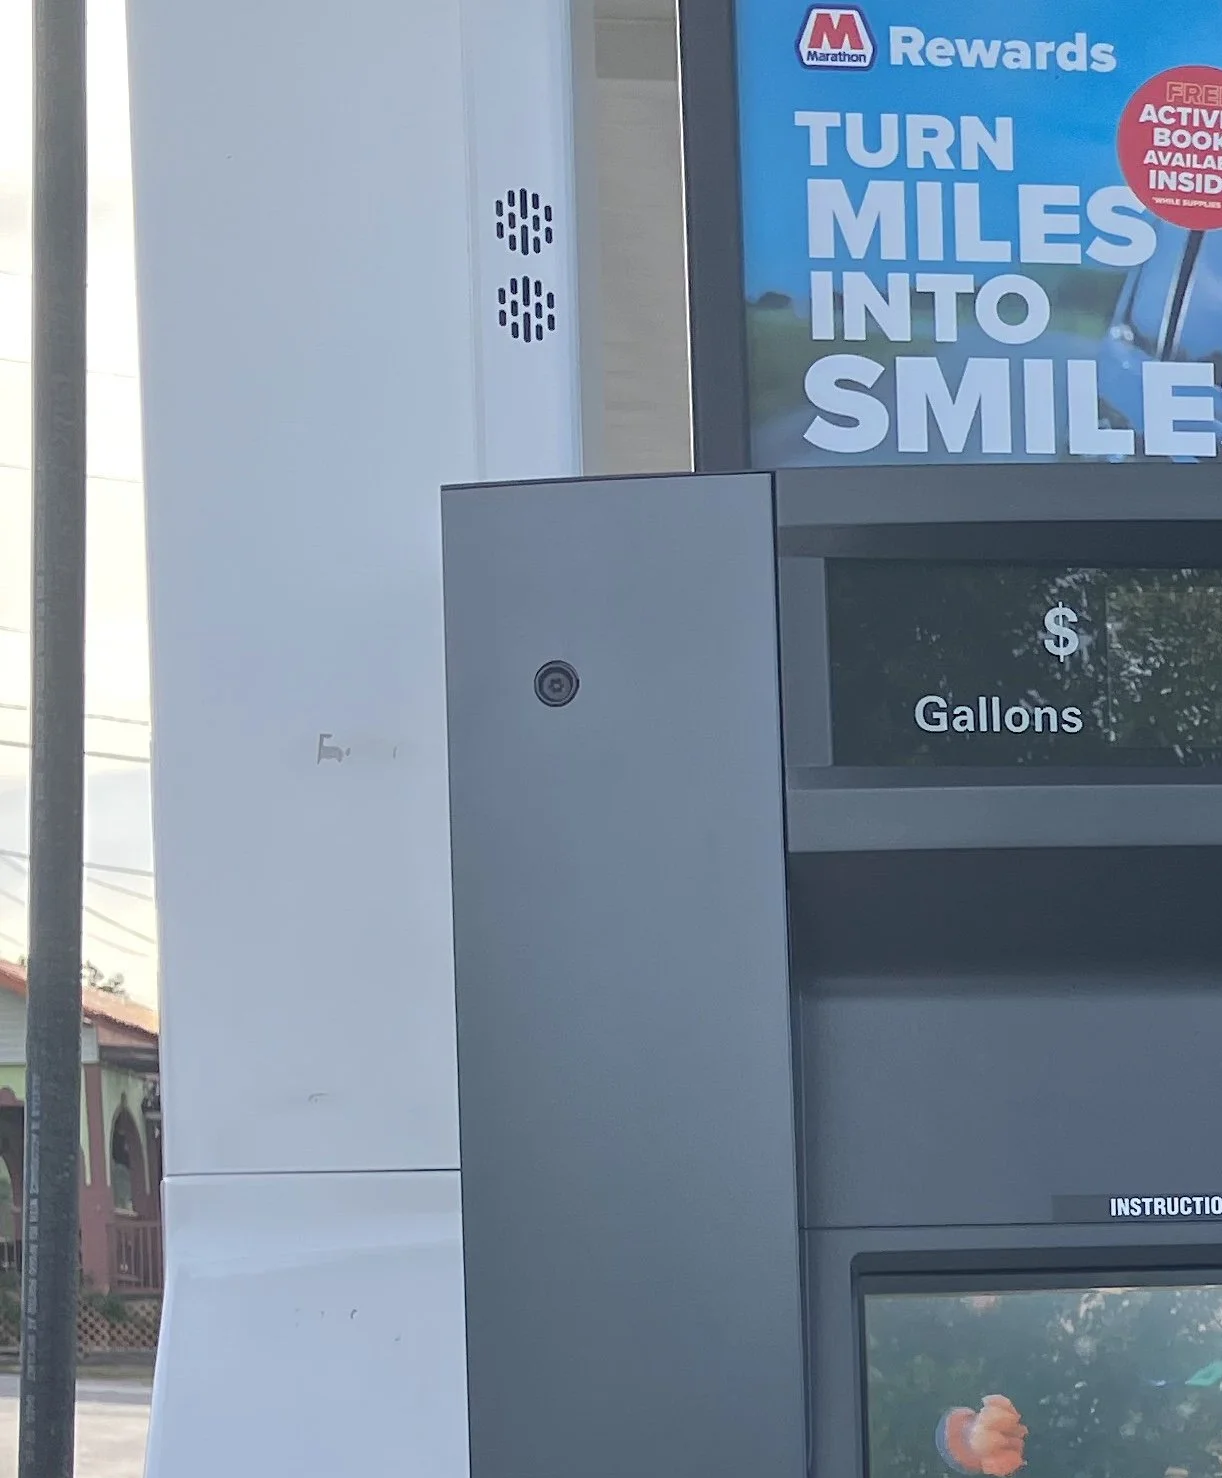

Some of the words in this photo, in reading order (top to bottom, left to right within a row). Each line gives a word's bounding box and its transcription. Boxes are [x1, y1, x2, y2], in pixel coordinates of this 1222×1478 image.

[806, 50, 866, 63] Marathon
[889, 26, 1117, 73] Rewards
[794, 111, 1014, 171] TURN
[807, 178, 1157, 267] MILES
[1182, 199, 1222, 210] SUPPLIES
[809, 270, 1051, 345] INTO
[1043, 600, 1079, 662] $
[914, 696, 1085, 735] Gallons
